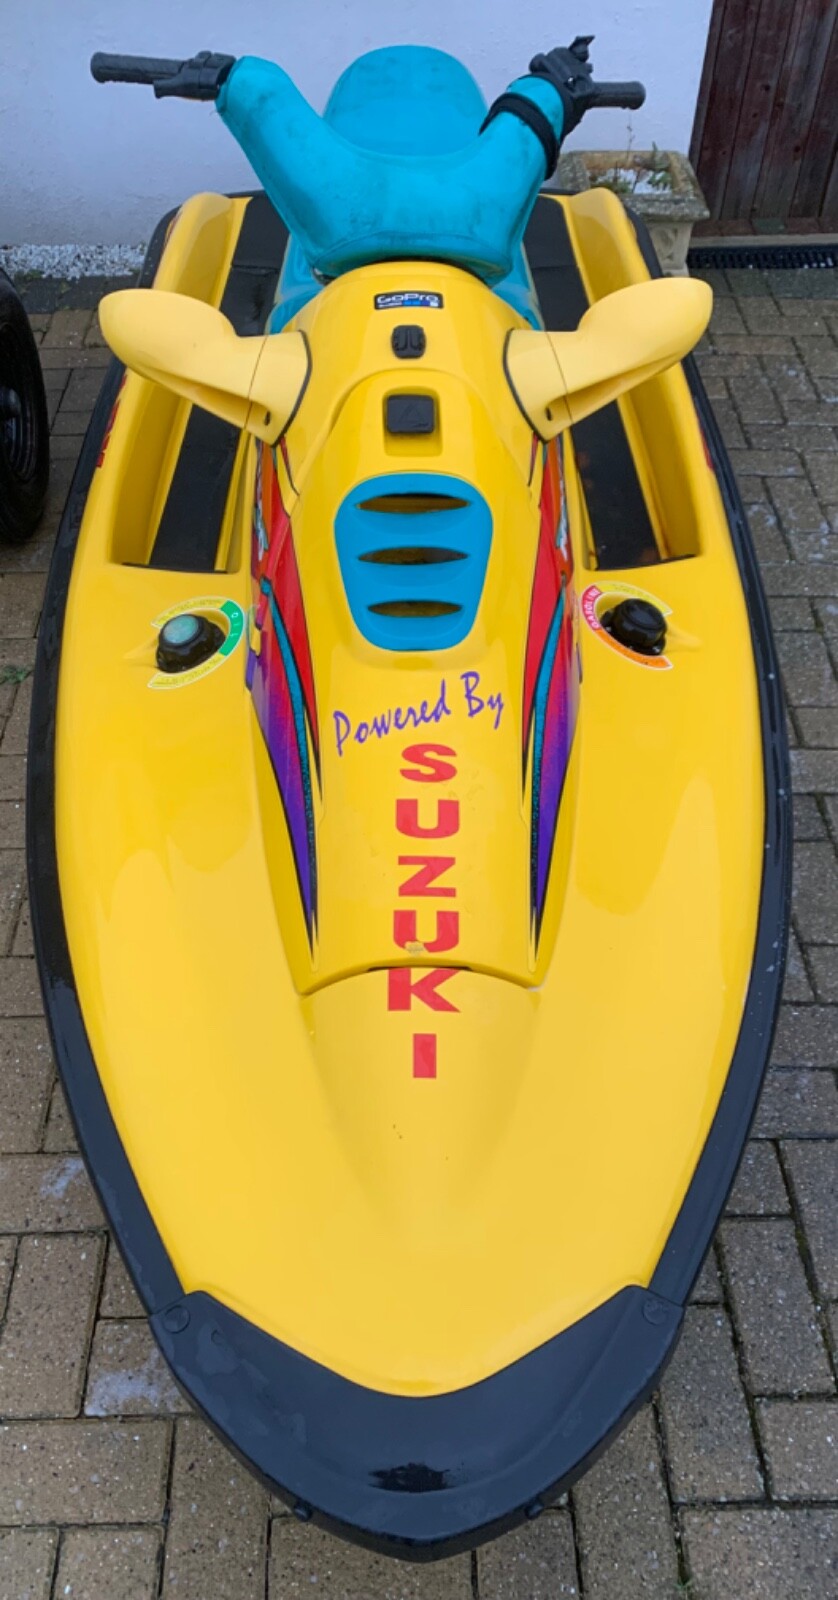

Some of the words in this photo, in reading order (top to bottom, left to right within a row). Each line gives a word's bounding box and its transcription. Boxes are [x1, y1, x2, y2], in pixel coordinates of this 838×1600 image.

[377, 293, 438, 303] GoPro
[333, 679, 451, 756] Powered
[460, 671, 504, 730] By
[387, 743, 460, 1078] SUZUKI
